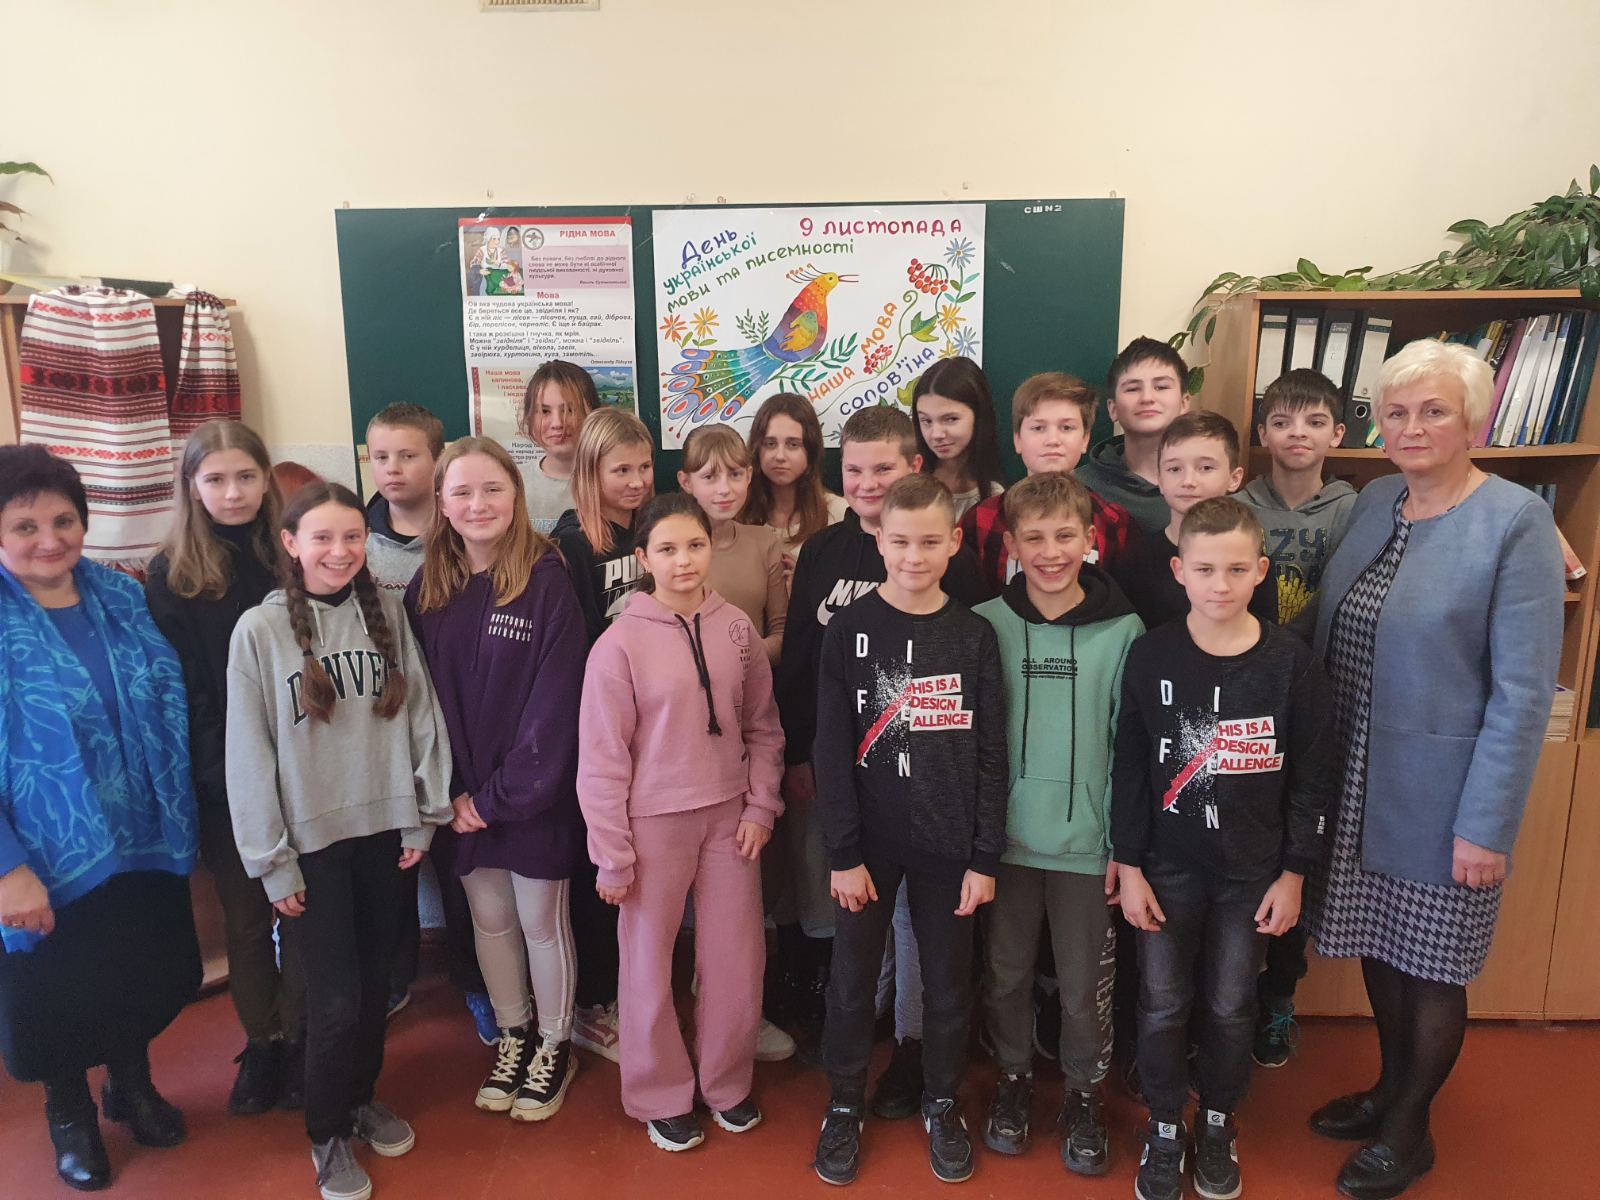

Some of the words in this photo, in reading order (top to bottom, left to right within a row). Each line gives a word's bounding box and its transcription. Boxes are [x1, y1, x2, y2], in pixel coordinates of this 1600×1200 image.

[560, 230, 587, 238] РІДНА
[590, 230, 616, 238] МОВА
[799, 217, 813, 236] 9
[681, 229, 737, 269] День
[663, 232, 757, 296] української
[667, 282, 711, 313] мови
[716, 267, 741, 287] та
[745, 238, 854, 271] писемності
[537, 291, 560, 299] Мова
[936, 678, 947, 692] IS
[949, 677, 959, 690] A
[910, 696, 957, 711] DESIGN
[1246, 721, 1258, 736] IS
[1261, 719, 1272, 733] A
[1217, 738, 1270, 756] DESIGN
